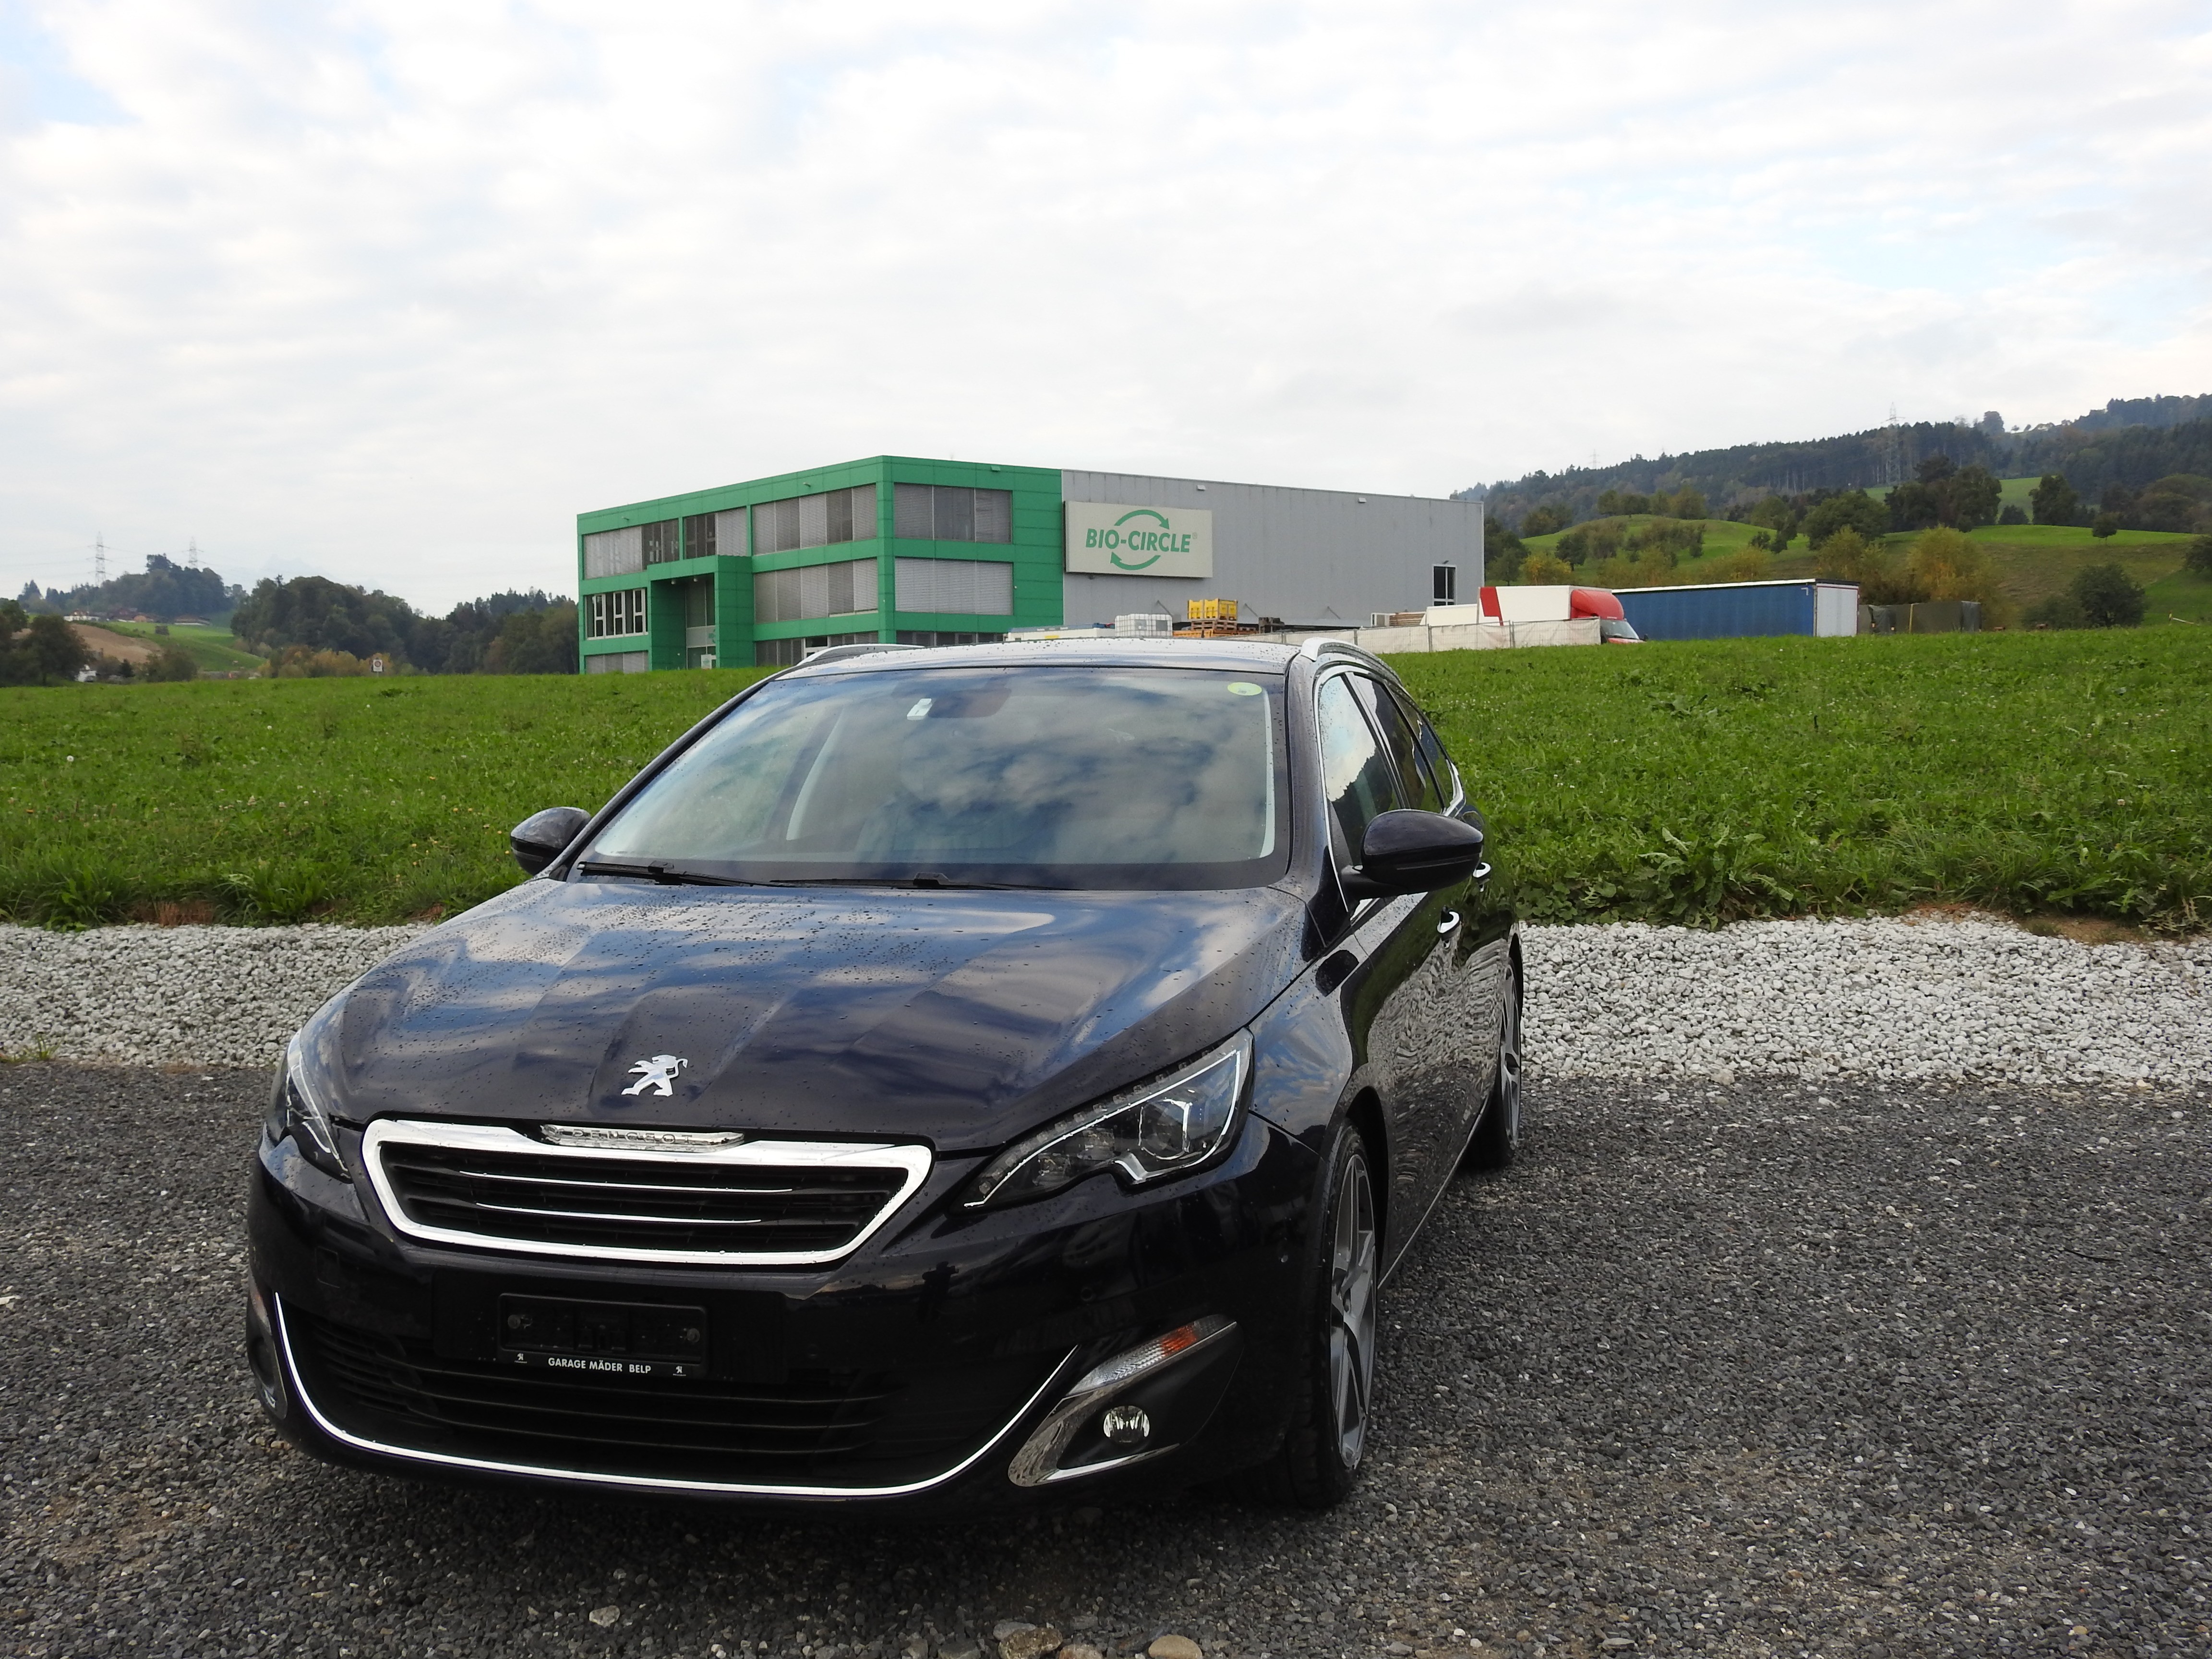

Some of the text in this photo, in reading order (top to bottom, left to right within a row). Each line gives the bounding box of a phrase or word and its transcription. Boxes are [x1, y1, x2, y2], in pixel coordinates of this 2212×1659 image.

[1085, 528, 1191, 553] BIO-CIRCLE
[572, 1129, 693, 1144] PEUGEOT
[548, 1358, 651, 1373] GARAGE MÄDER BELP
